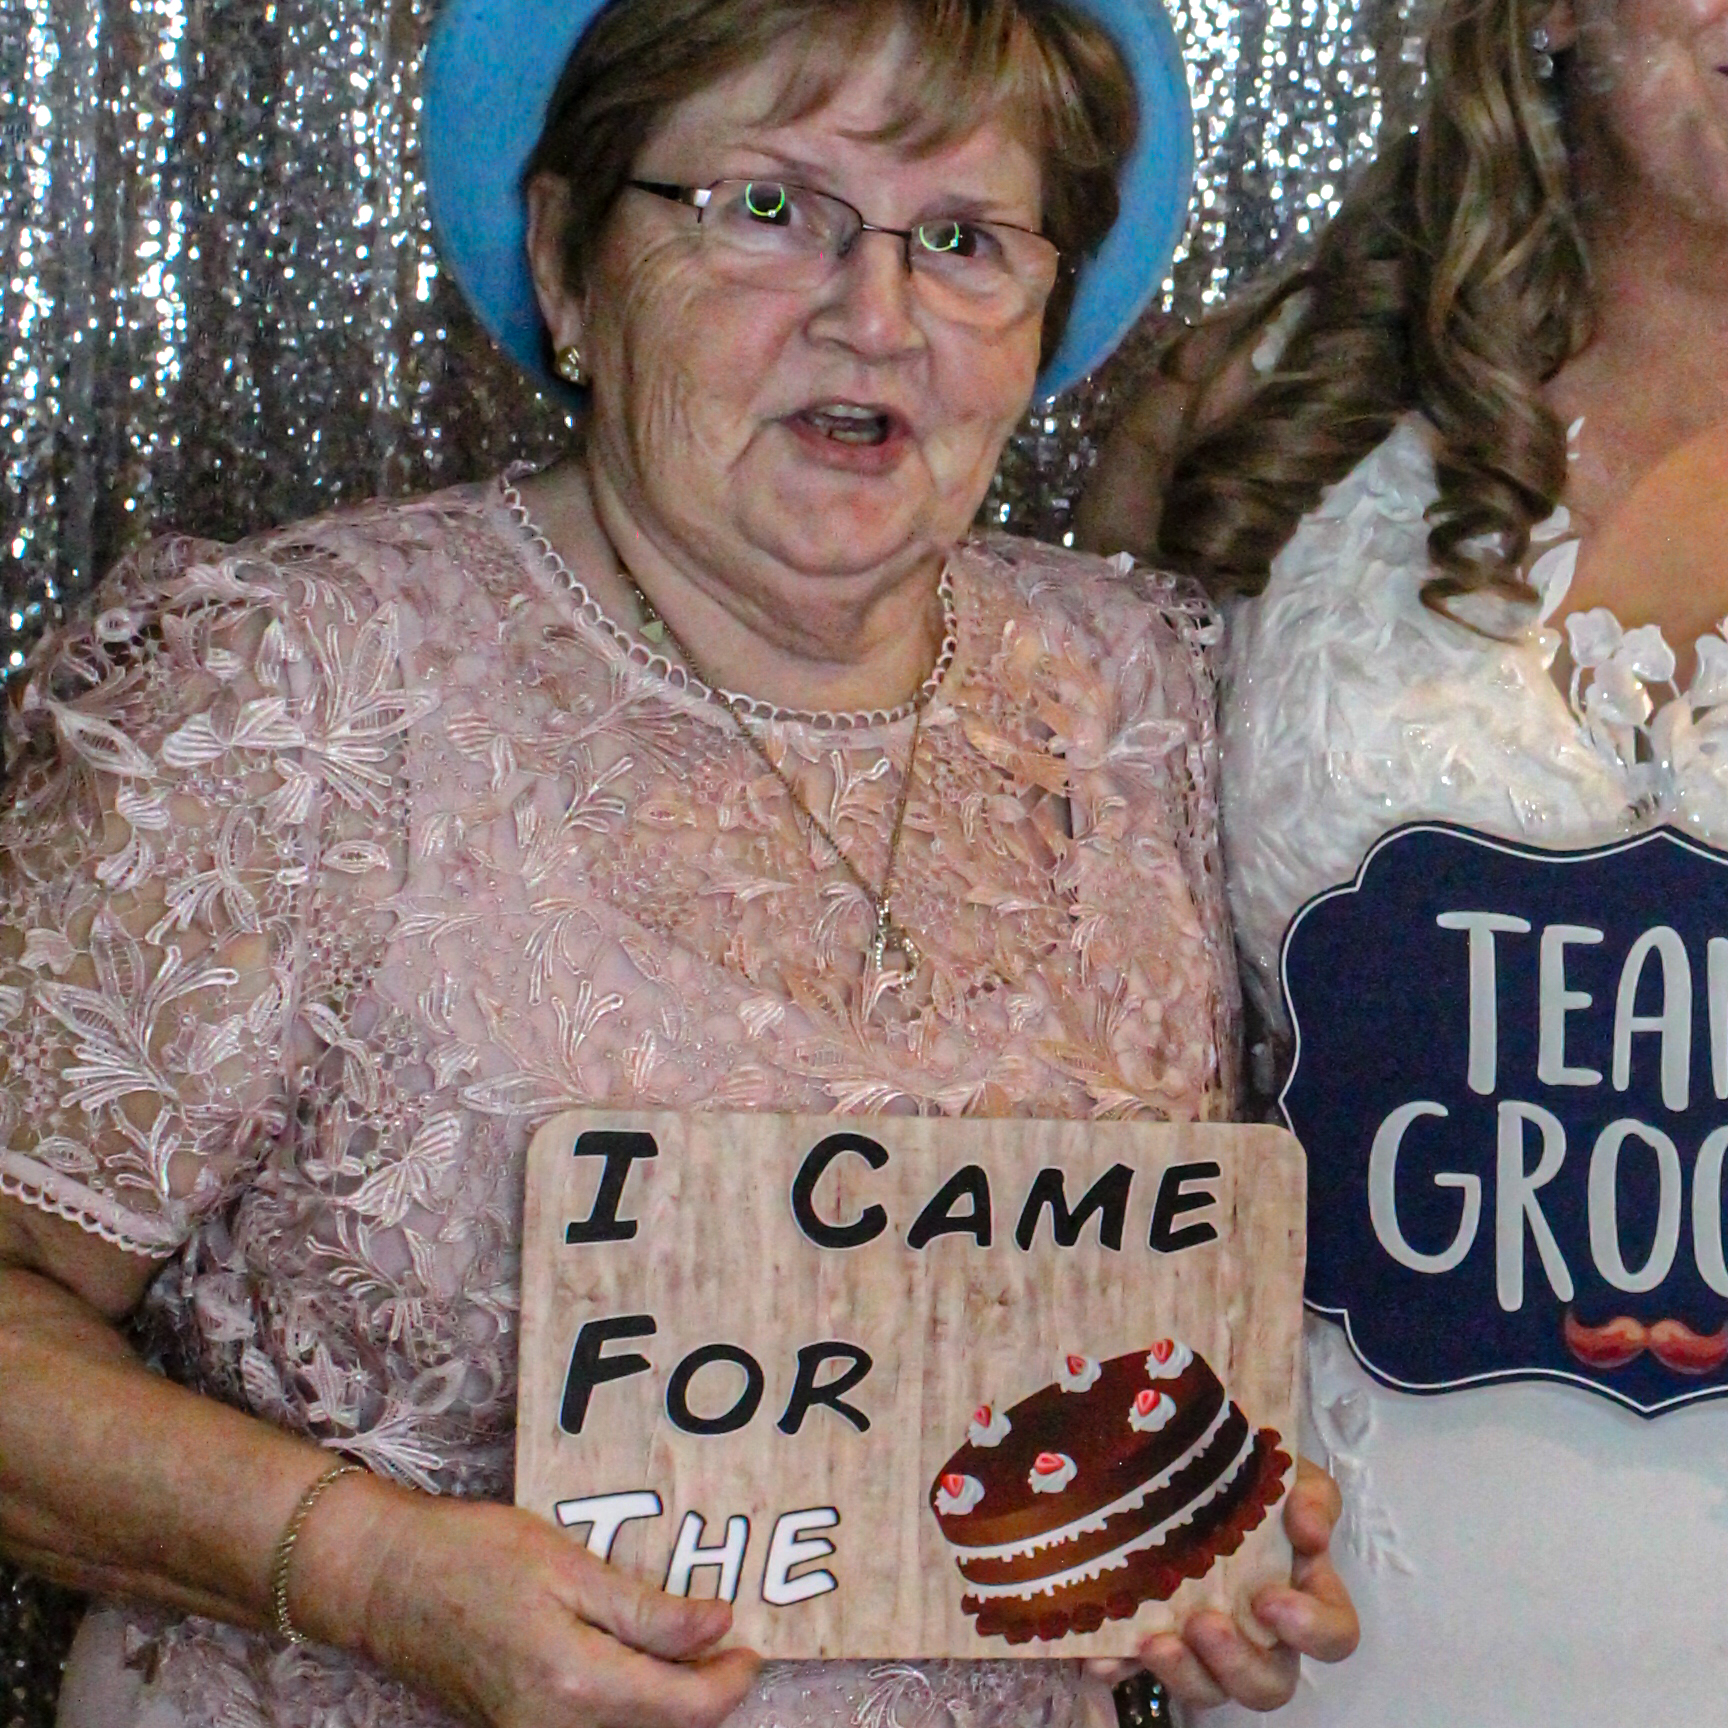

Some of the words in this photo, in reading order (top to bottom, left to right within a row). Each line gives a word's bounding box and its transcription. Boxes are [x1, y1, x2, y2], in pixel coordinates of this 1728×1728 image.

[565, 1130, 659, 1245] I
[790, 1131, 1221, 1253] CAME
[557, 1313, 873, 1435] FOR
[555, 1490, 841, 1607] THE
